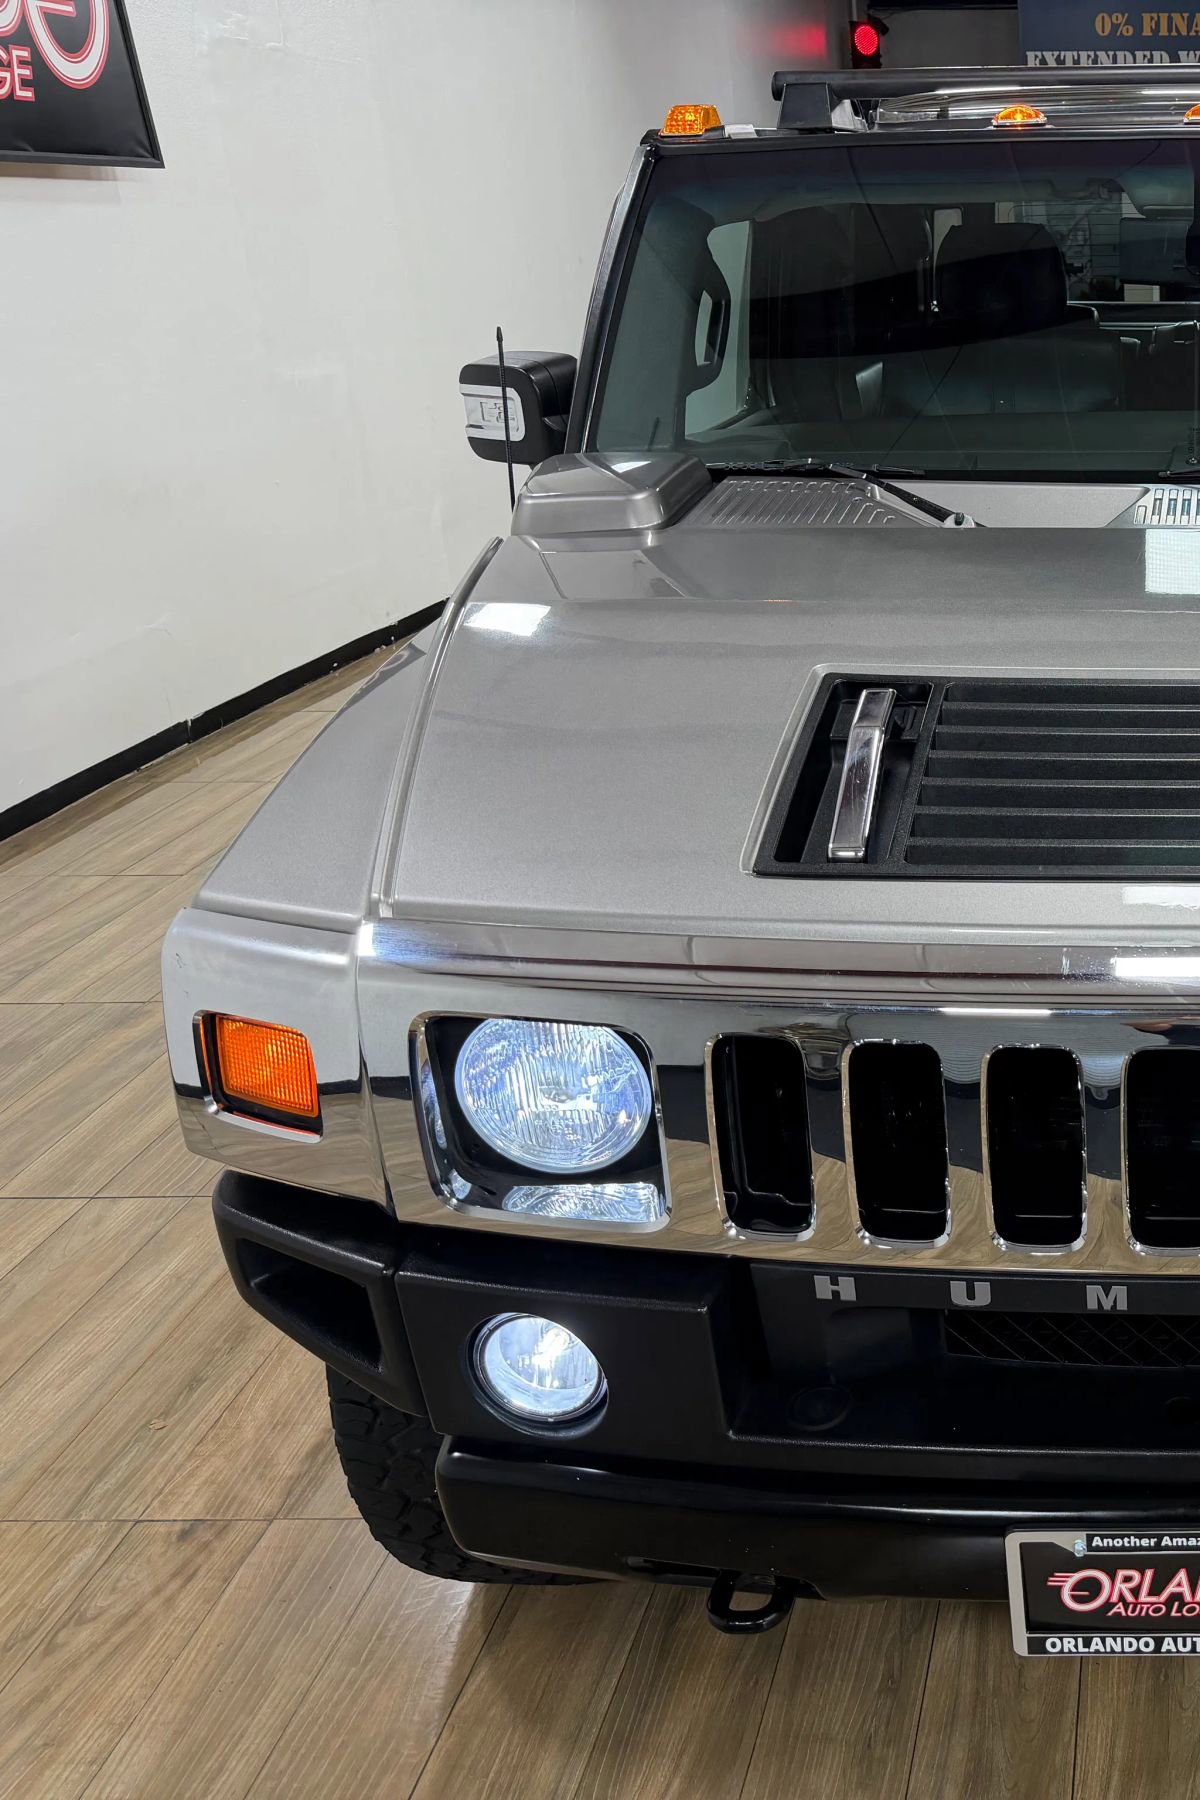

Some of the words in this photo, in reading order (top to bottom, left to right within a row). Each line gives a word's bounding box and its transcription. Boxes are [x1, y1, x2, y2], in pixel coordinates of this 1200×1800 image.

[1095, 13, 1134, 37] 0%
[1092, 1536, 1157, 1547] Another
[1045, 1637, 1155, 1653] ORLANDO
